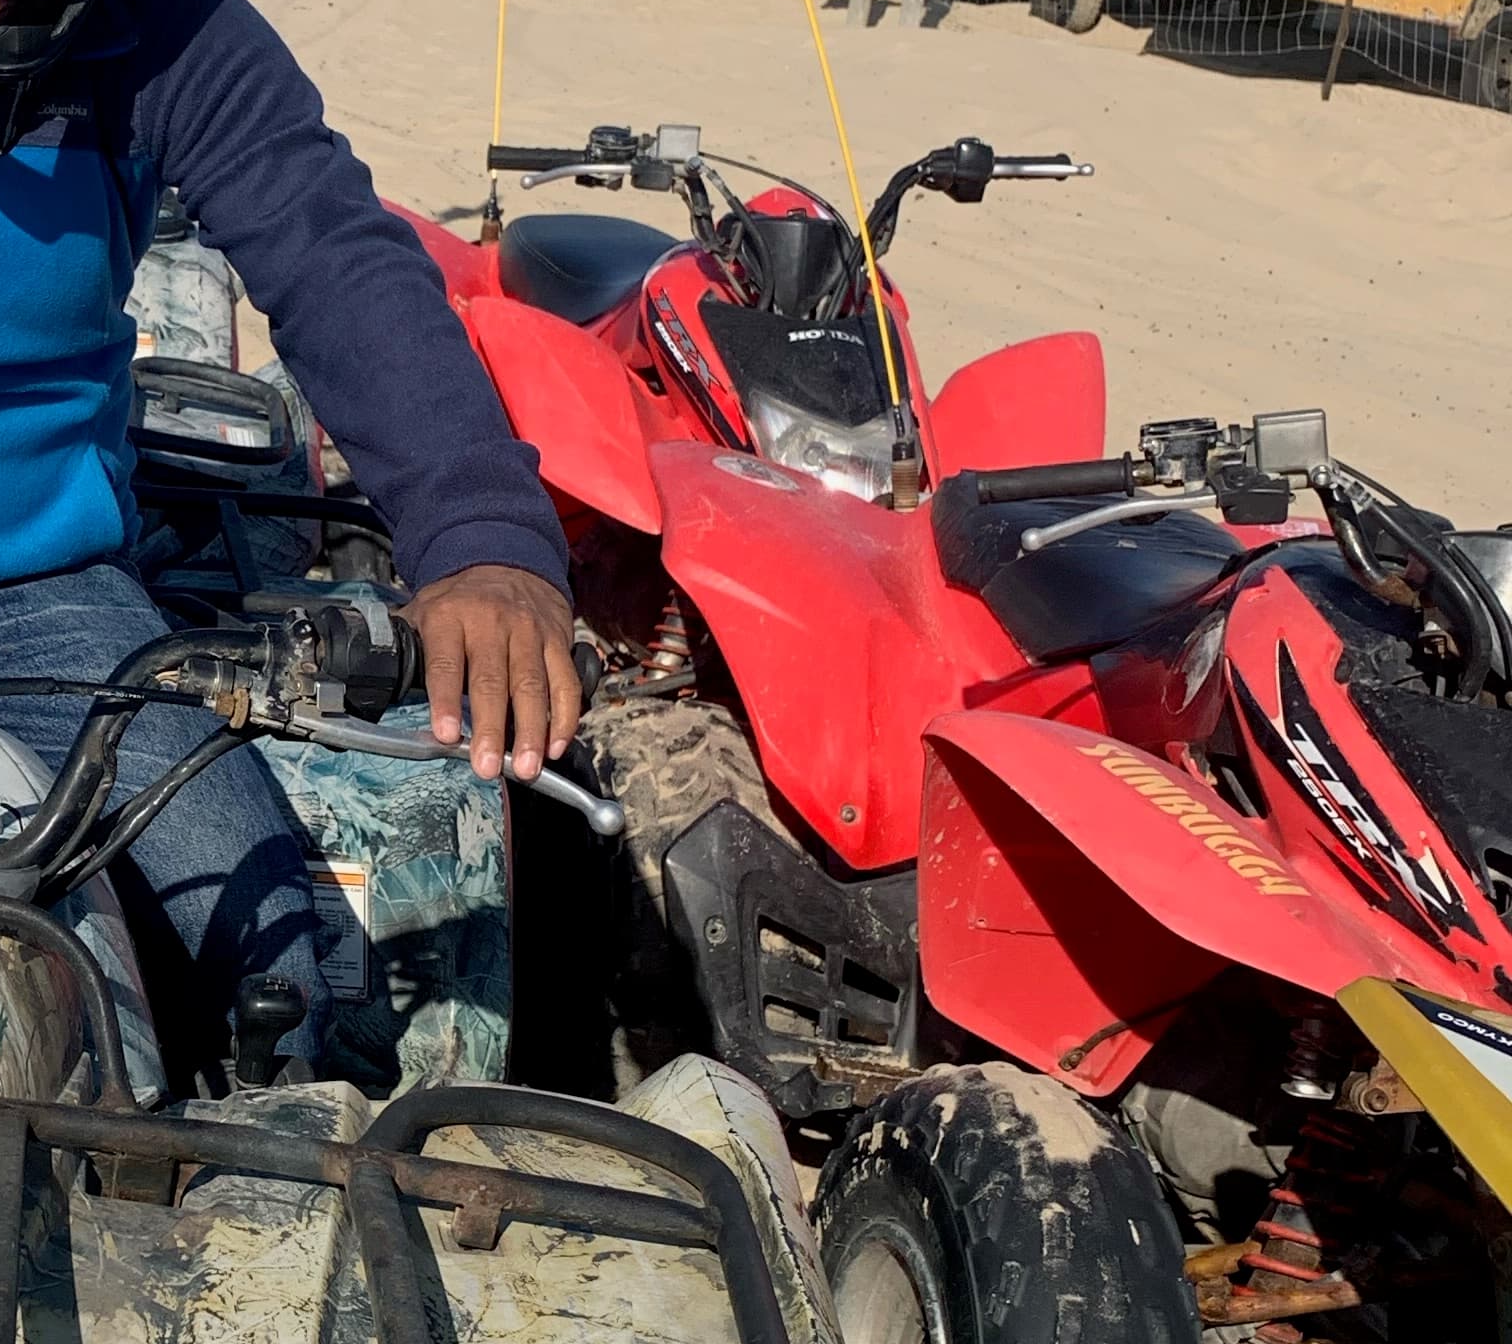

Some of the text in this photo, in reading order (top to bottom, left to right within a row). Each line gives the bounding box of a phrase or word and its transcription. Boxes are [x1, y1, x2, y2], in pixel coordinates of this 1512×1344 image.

[1076, 742, 1312, 897] SUNBUGGY
[1286, 758, 1374, 860] 250EX
[1293, 722, 1448, 915] TRX
